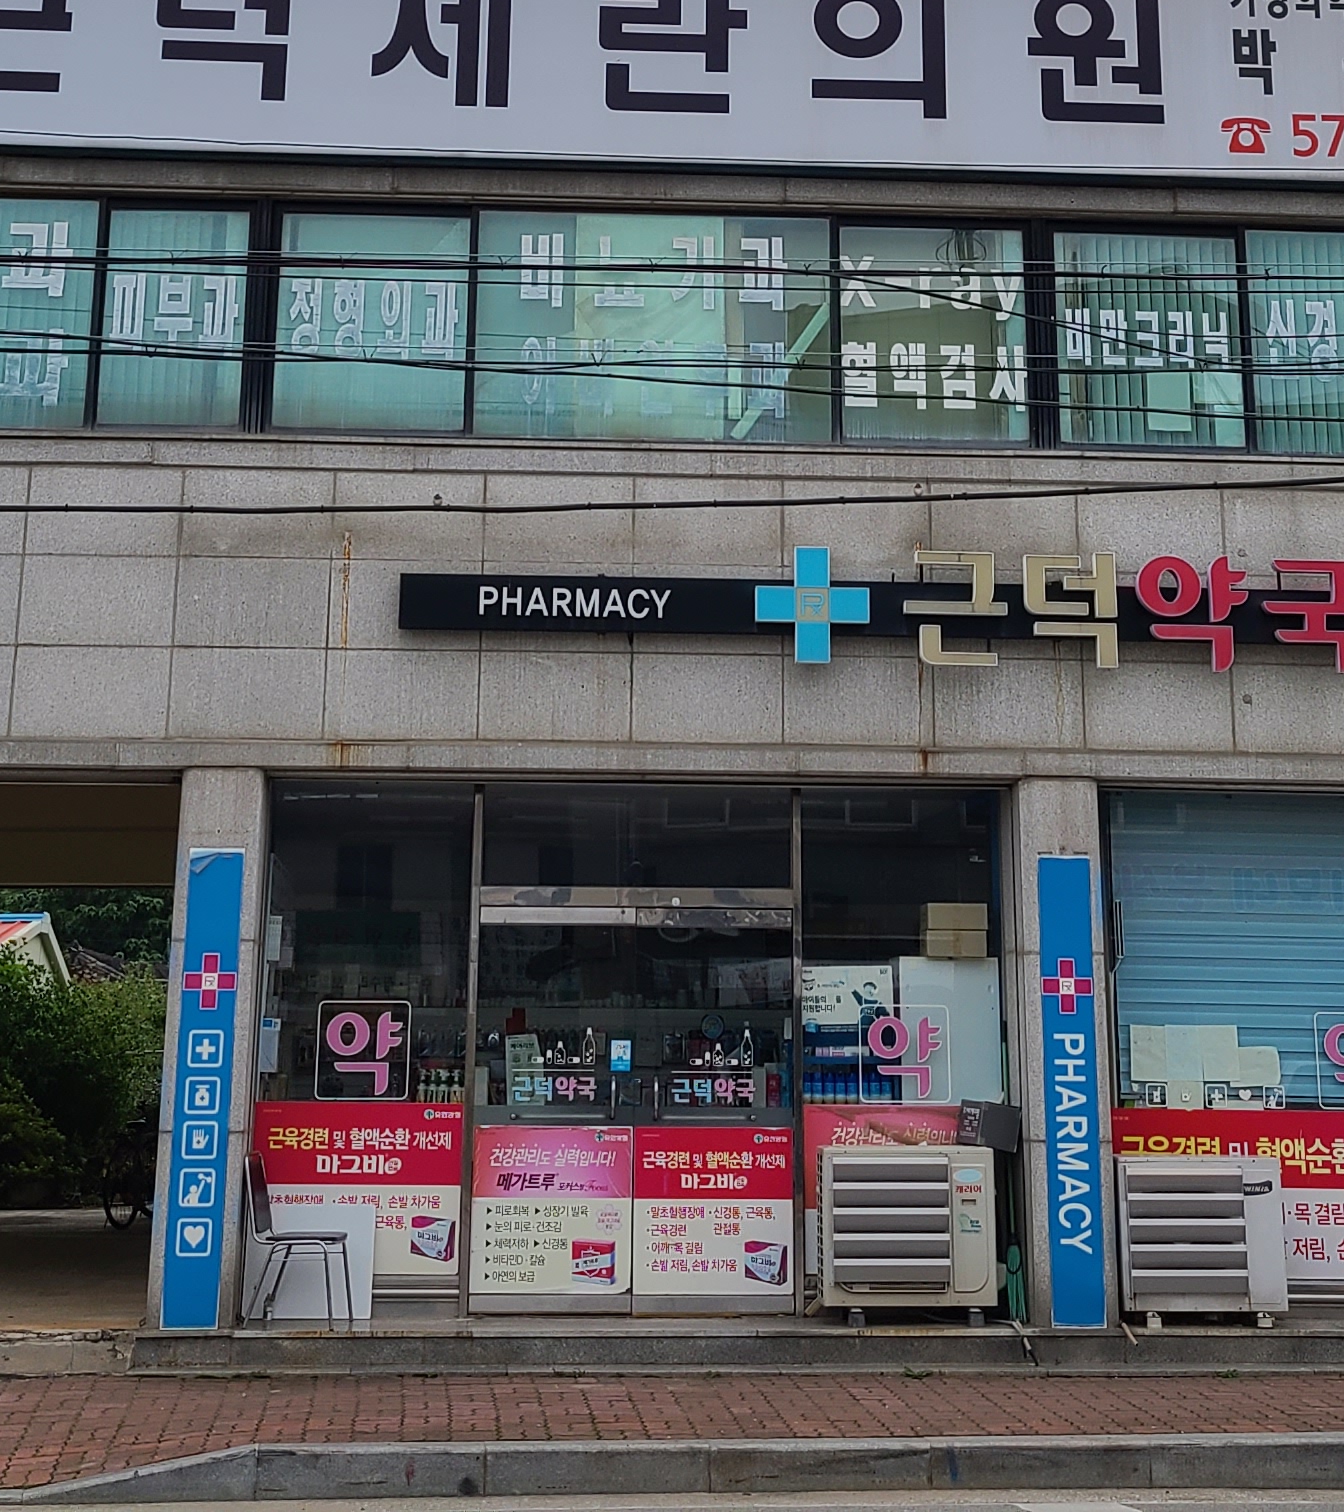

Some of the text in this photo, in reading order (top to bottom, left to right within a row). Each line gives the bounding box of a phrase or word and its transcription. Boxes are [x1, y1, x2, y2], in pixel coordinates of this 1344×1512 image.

[520, 233, 788, 311] 비뇨기과
[840, 255, 1024, 322] X-ray
[108, 273, 238, 357] 피부과
[290, 278, 458, 360] 정형외과
[841, 341, 1027, 413] 혈액검사
[478, 586, 672, 619] PHARMACY
[326, 1012, 403, 1096] 약
[868, 1016, 942, 1099] 약
[512, 1076, 597, 1102] 근덕약국
[672, 1078, 756, 1103] 근덕약국
[268, 1127, 452, 1150] 근육경련 및 혈액순환 개선제
[1053, 1033, 1093, 1255] PHARMACY
[316, 1153, 385, 1175] 마그비
[490, 1147, 616, 1168] 건강관리도 실력입니다!
[642, 1151, 786, 1169] 근육경련 및 혈액순환 개선제
[497, 1172, 556, 1191] 메가트루
[680, 1173, 734, 1190] 마그비
[388, 1195, 409, 1208] 손발
[411, 1195, 441, 1209] 차가움
[494, 1205, 529, 1217] 피로회복
[494, 1222, 512, 1233] 눈의
[492, 1254, 524, 1266] 비타민D
[1293, 1237, 1331, 1263] 저림,
[492, 1271, 535, 1282] 아연의 보급
